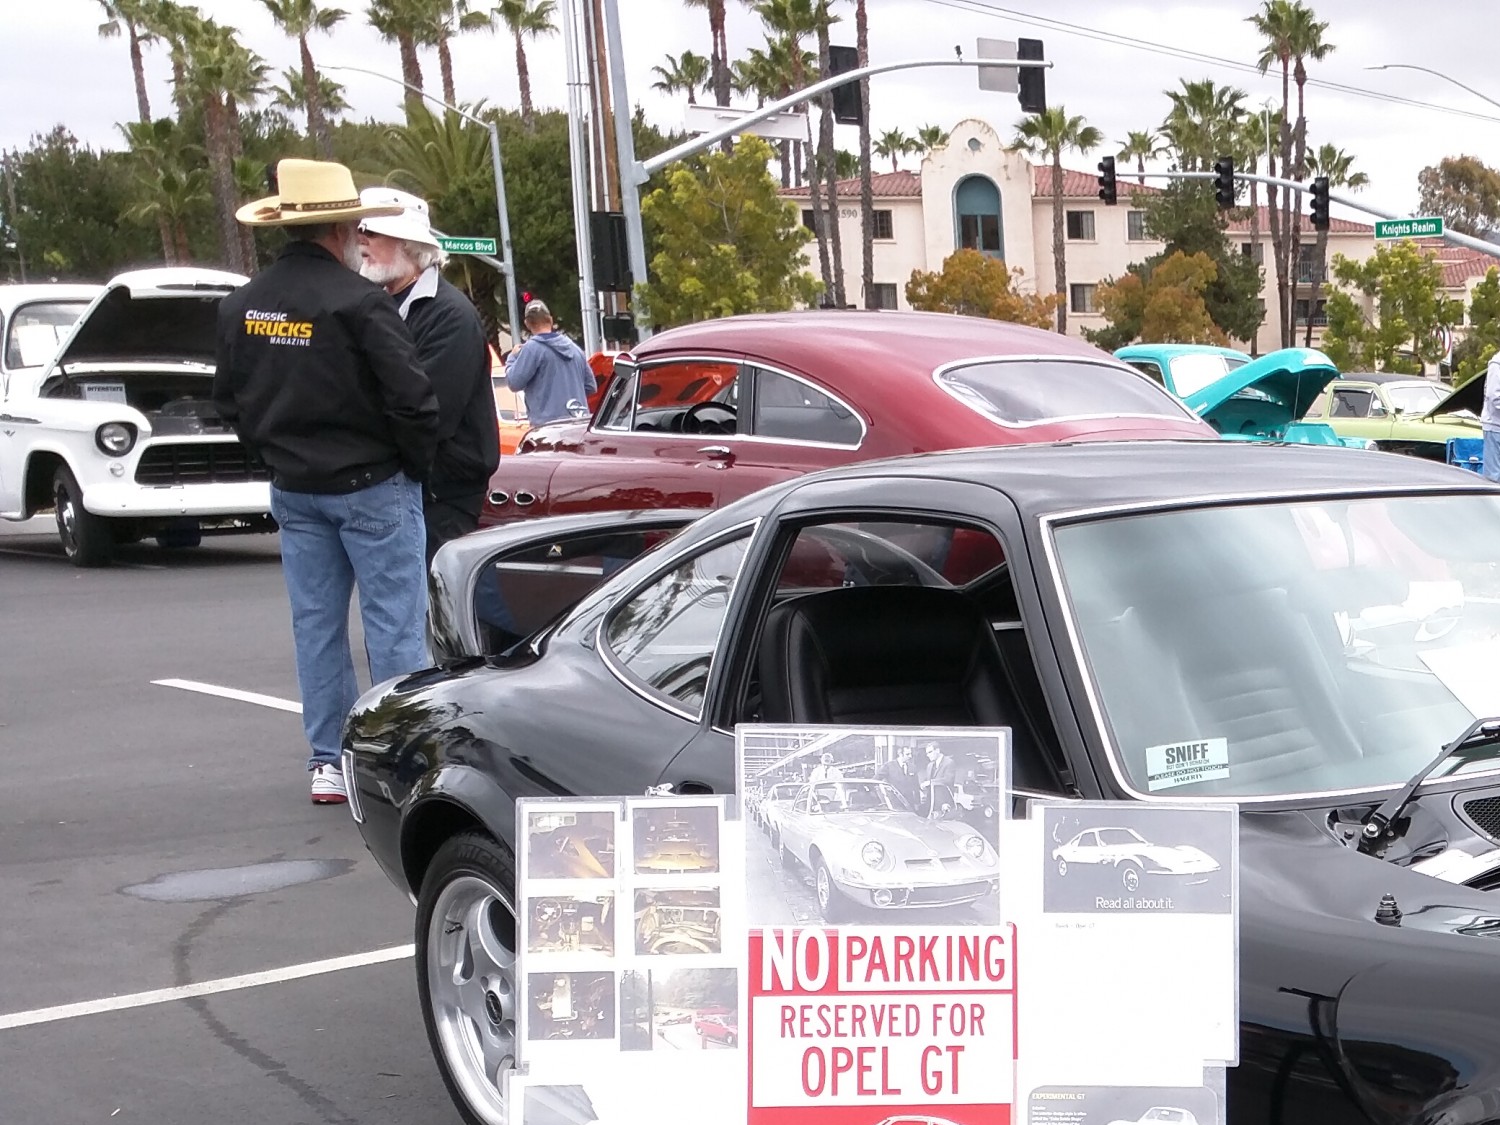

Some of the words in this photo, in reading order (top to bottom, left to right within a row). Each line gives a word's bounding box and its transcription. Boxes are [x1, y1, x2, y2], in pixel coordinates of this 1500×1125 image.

[1382, 223, 1410, 236] Knights
[1411, 222, 1436, 233] Realm
[445, 241, 474, 250] Marcos
[475, 242, 493, 251] Blvd
[245, 309, 288, 322] Classic
[244, 320, 314, 338] TRUCKS
[269, 336, 311, 347] MAGAZINE
[1165, 742, 1209, 765] SNIFF
[1095, 896, 1121, 909] Read
[1123, 897, 1135, 909] all
[1135, 897, 1165, 909] about
[1166, 897, 1175, 909] it.
[761, 928, 830, 992] NO
[846, 935, 1005, 983] PARKING
[780, 1003, 921, 1038] RESERVED
[932, 1002, 985, 1037] FOR
[801, 1046, 901, 1097] OPEL
[920, 1045, 965, 1096] GT
